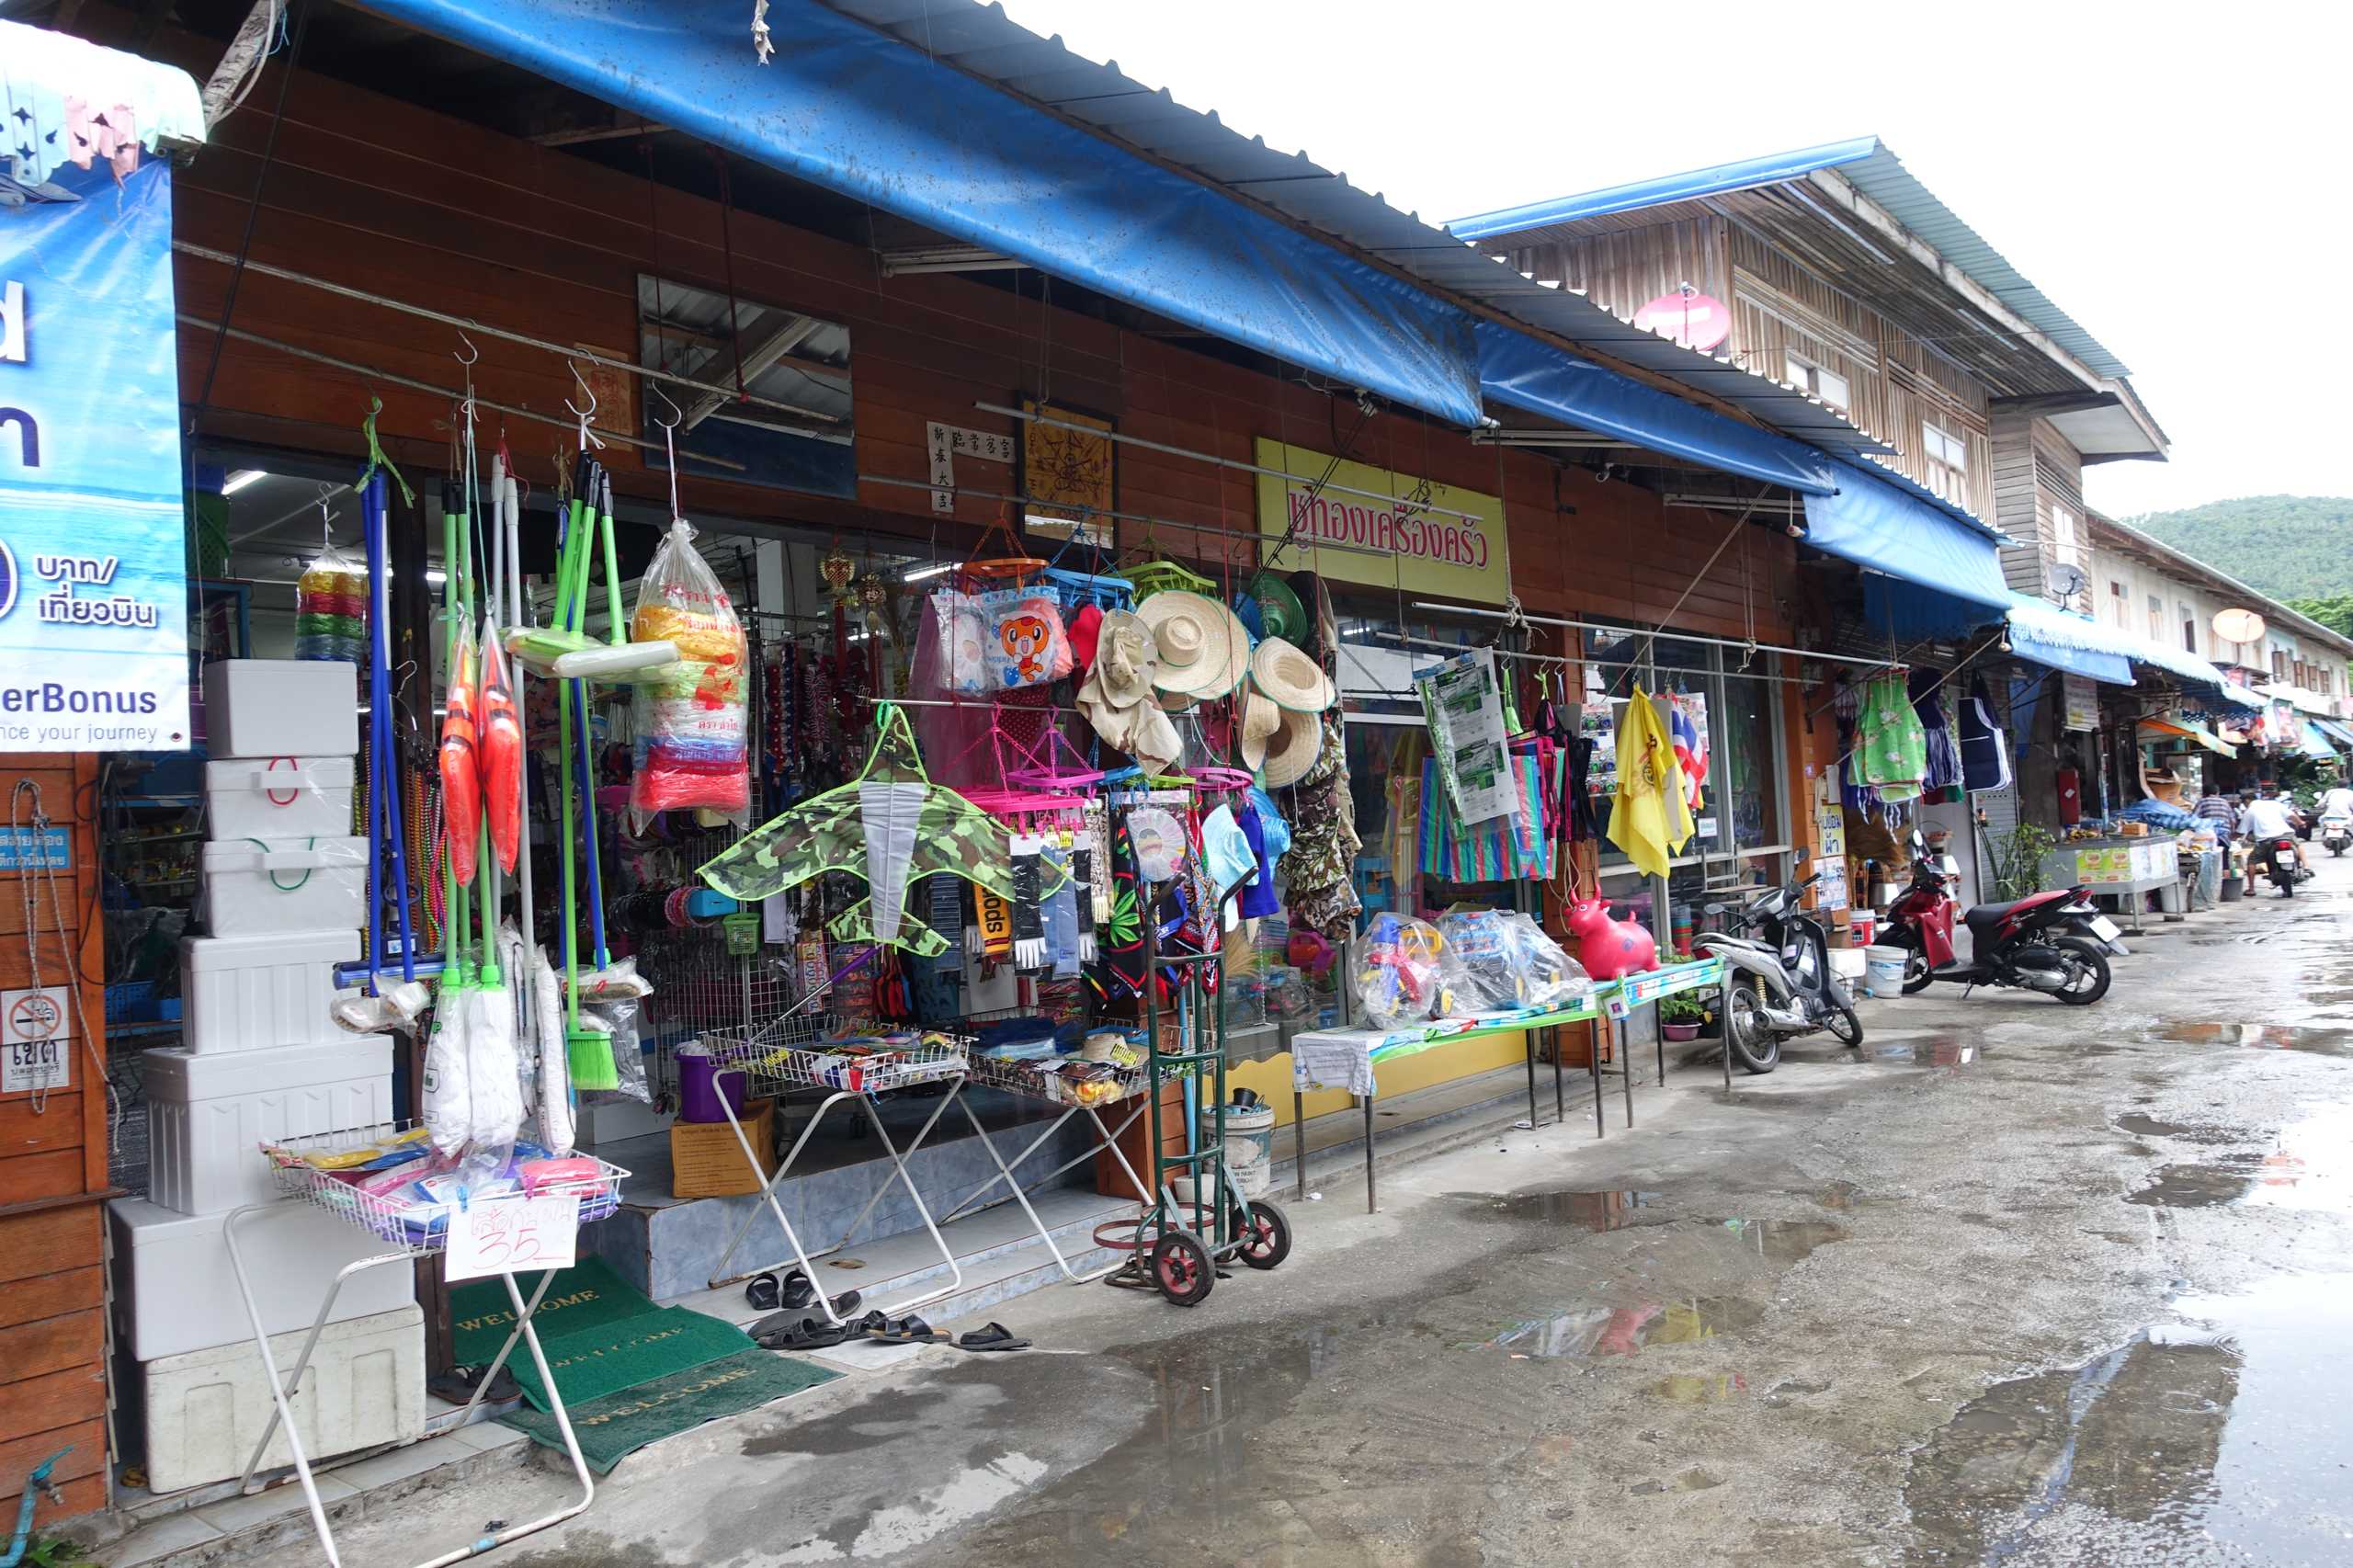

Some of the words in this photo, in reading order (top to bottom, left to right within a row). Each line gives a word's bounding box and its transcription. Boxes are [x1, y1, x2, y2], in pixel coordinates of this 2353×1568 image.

[39, 584, 154, 626] เที่ยวบิน
[38, 727, 82, 743] your
[87, 724, 158, 743] journey
[455, 1288, 601, 1332] WELOME
